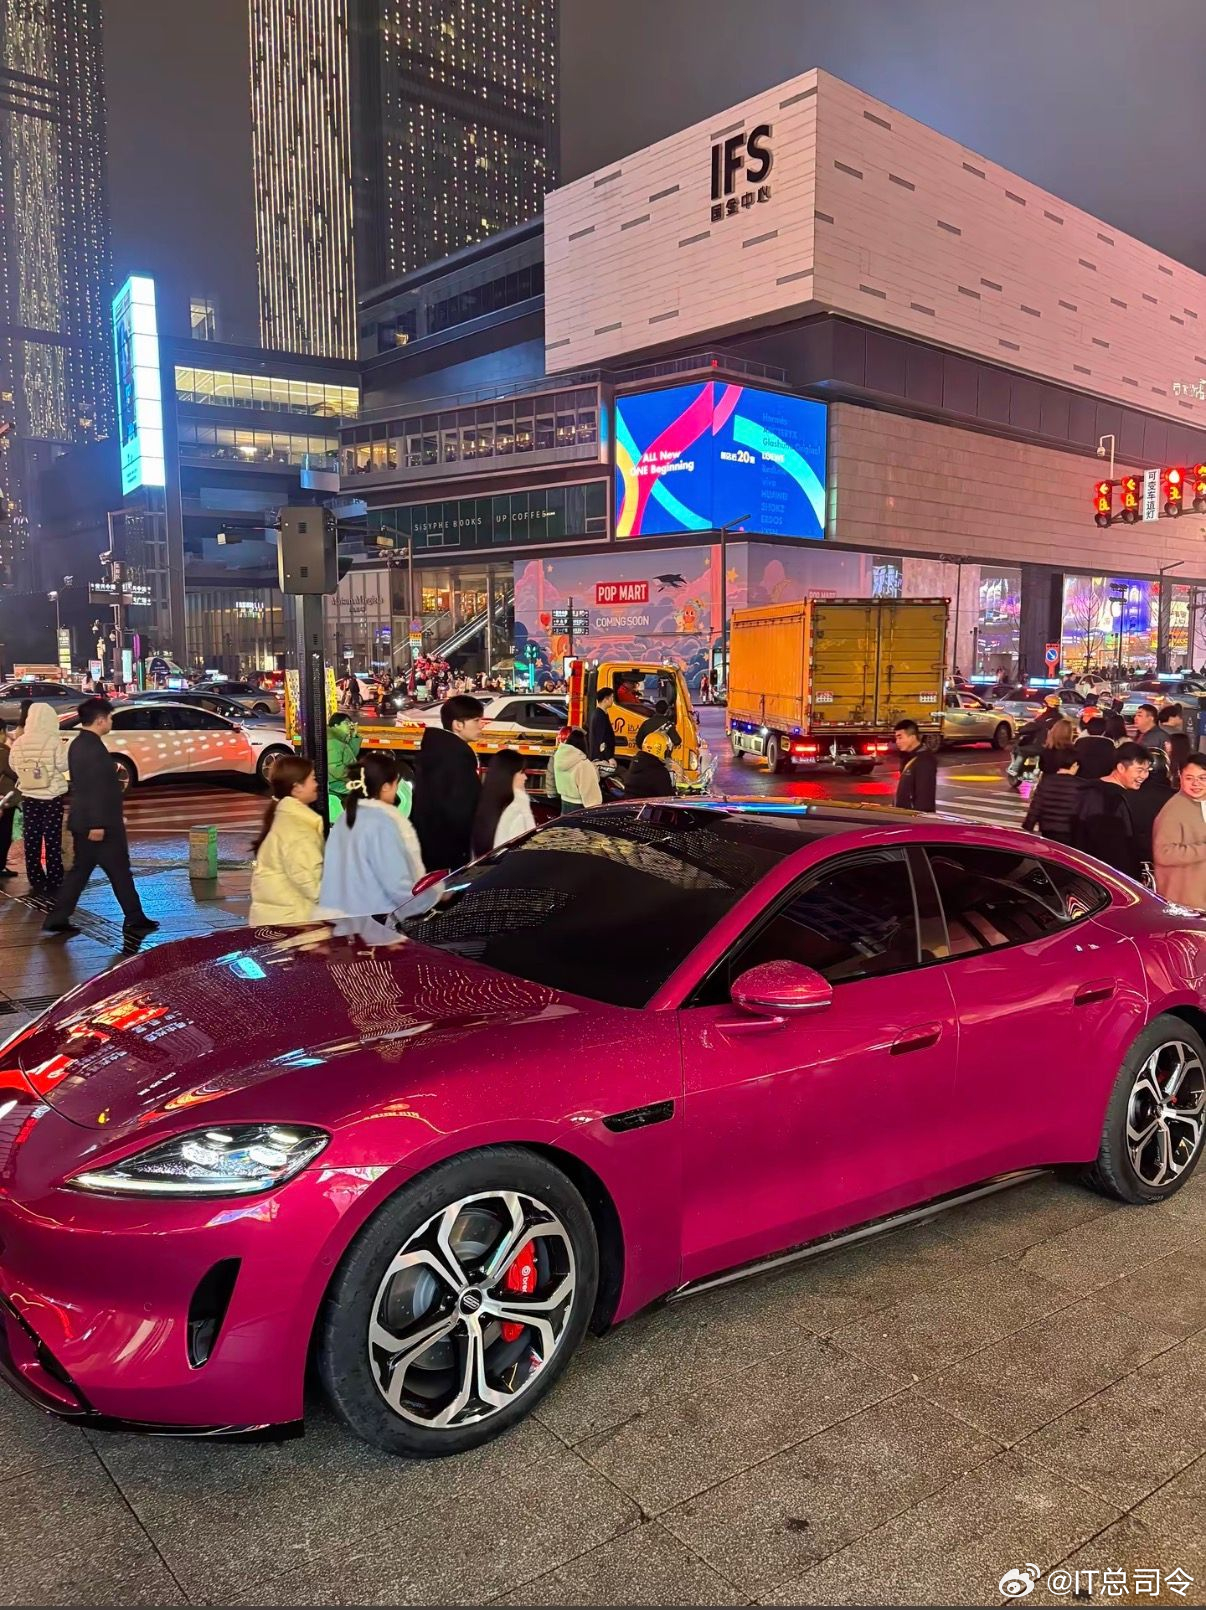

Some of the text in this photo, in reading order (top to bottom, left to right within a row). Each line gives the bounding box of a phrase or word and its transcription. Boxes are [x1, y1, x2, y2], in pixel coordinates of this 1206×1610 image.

[711, 125, 773, 201] IFS
[643, 449, 681, 462] ALL New
[630, 460, 694, 477] ONE Beginning
[1146, 471, 1156, 519] 可变车道灯
[452, 517, 482, 528] BOOKS
[496, 515, 507, 523] UP
[598, 584, 647, 601] POP MART
[596, 617, 626, 627] COMING
[627, 615, 650, 626] SOON
